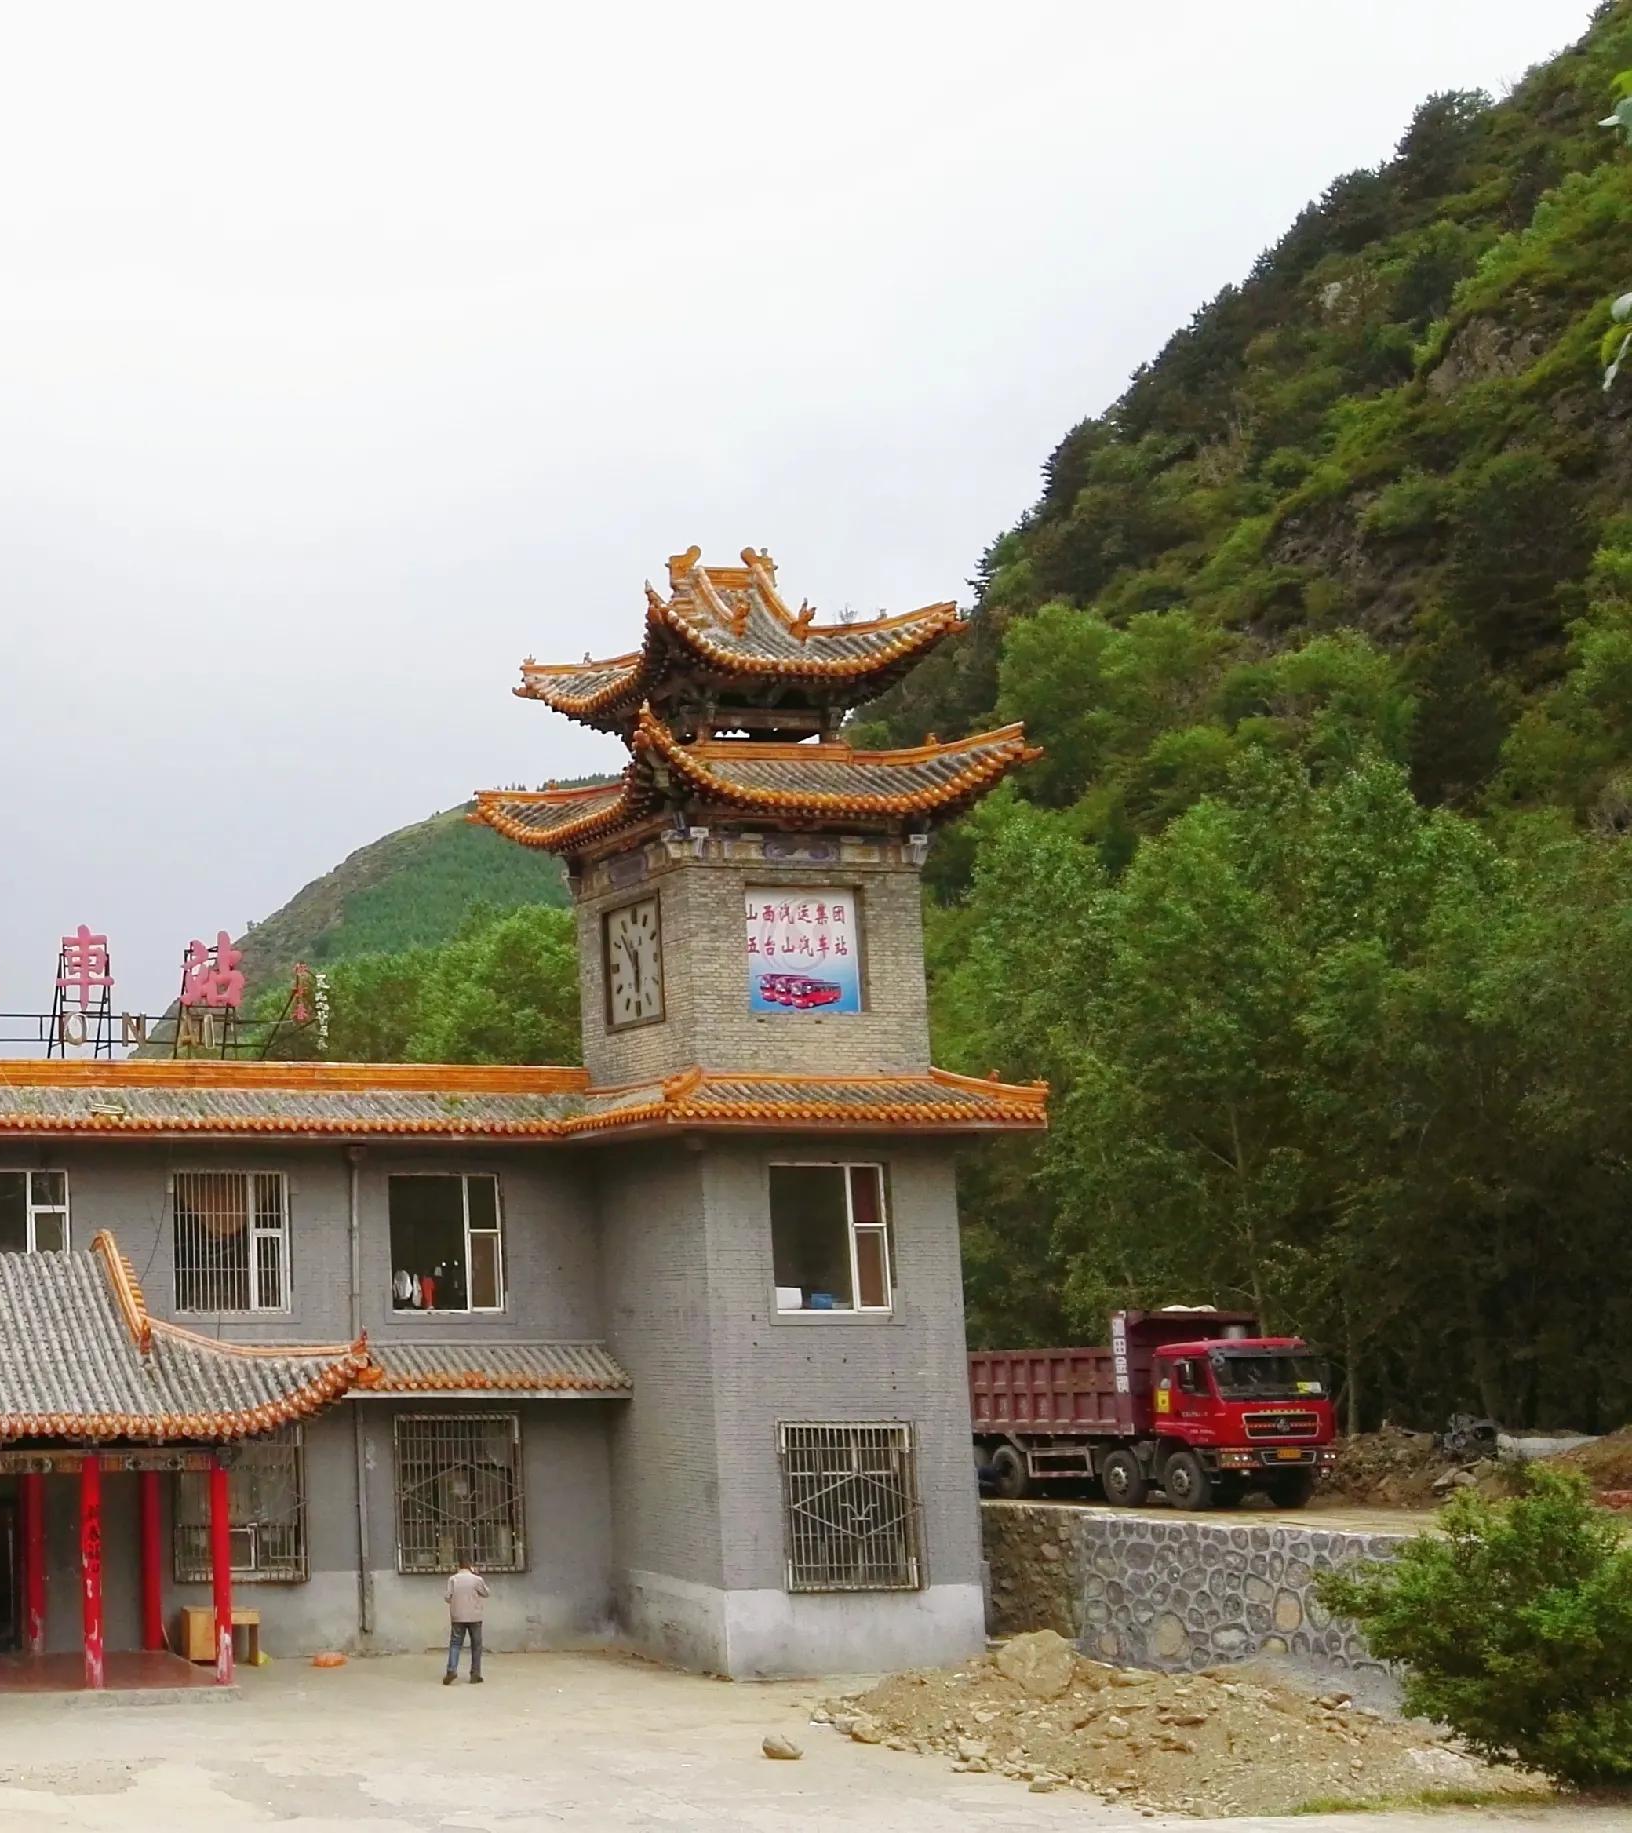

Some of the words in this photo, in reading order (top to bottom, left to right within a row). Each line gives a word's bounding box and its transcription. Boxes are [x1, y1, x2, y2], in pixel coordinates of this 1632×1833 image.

[746, 904, 845, 925] 山西汽运集团
[748, 935, 848, 958] 五台山汽车站
